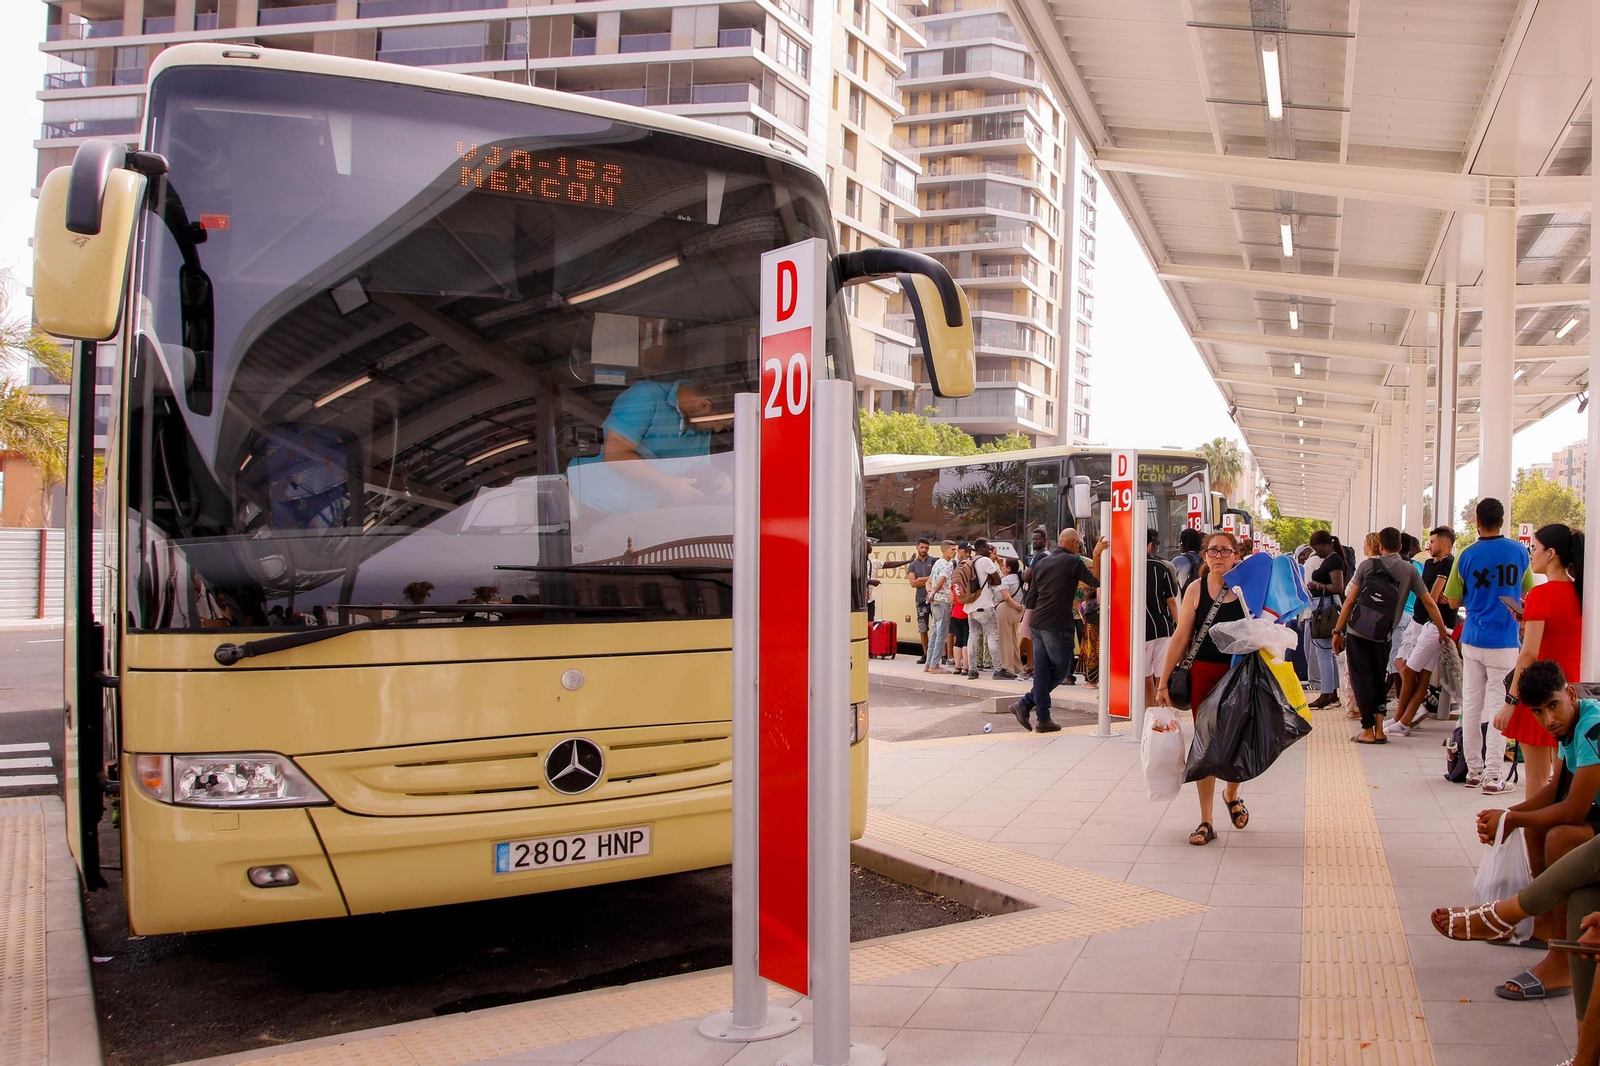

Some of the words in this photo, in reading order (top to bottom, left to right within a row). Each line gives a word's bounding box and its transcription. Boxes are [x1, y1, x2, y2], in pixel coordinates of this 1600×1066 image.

[456, 140, 622, 184] VJA-152
[461, 166, 614, 206] NEXCON
[776, 260, 798, 322] D
[764, 352, 808, 419] 20
[1118, 454, 1128, 477] D
[1112, 488, 1132, 512] 19
[1192, 496, 1199, 510] D
[1188, 516, 1201, 532] 18
[1225, 516, 1231, 526] D
[1523, 525, 1529, 535] D
[514, 837, 586, 868] 2802
[598, 830, 644, 857] HNP
